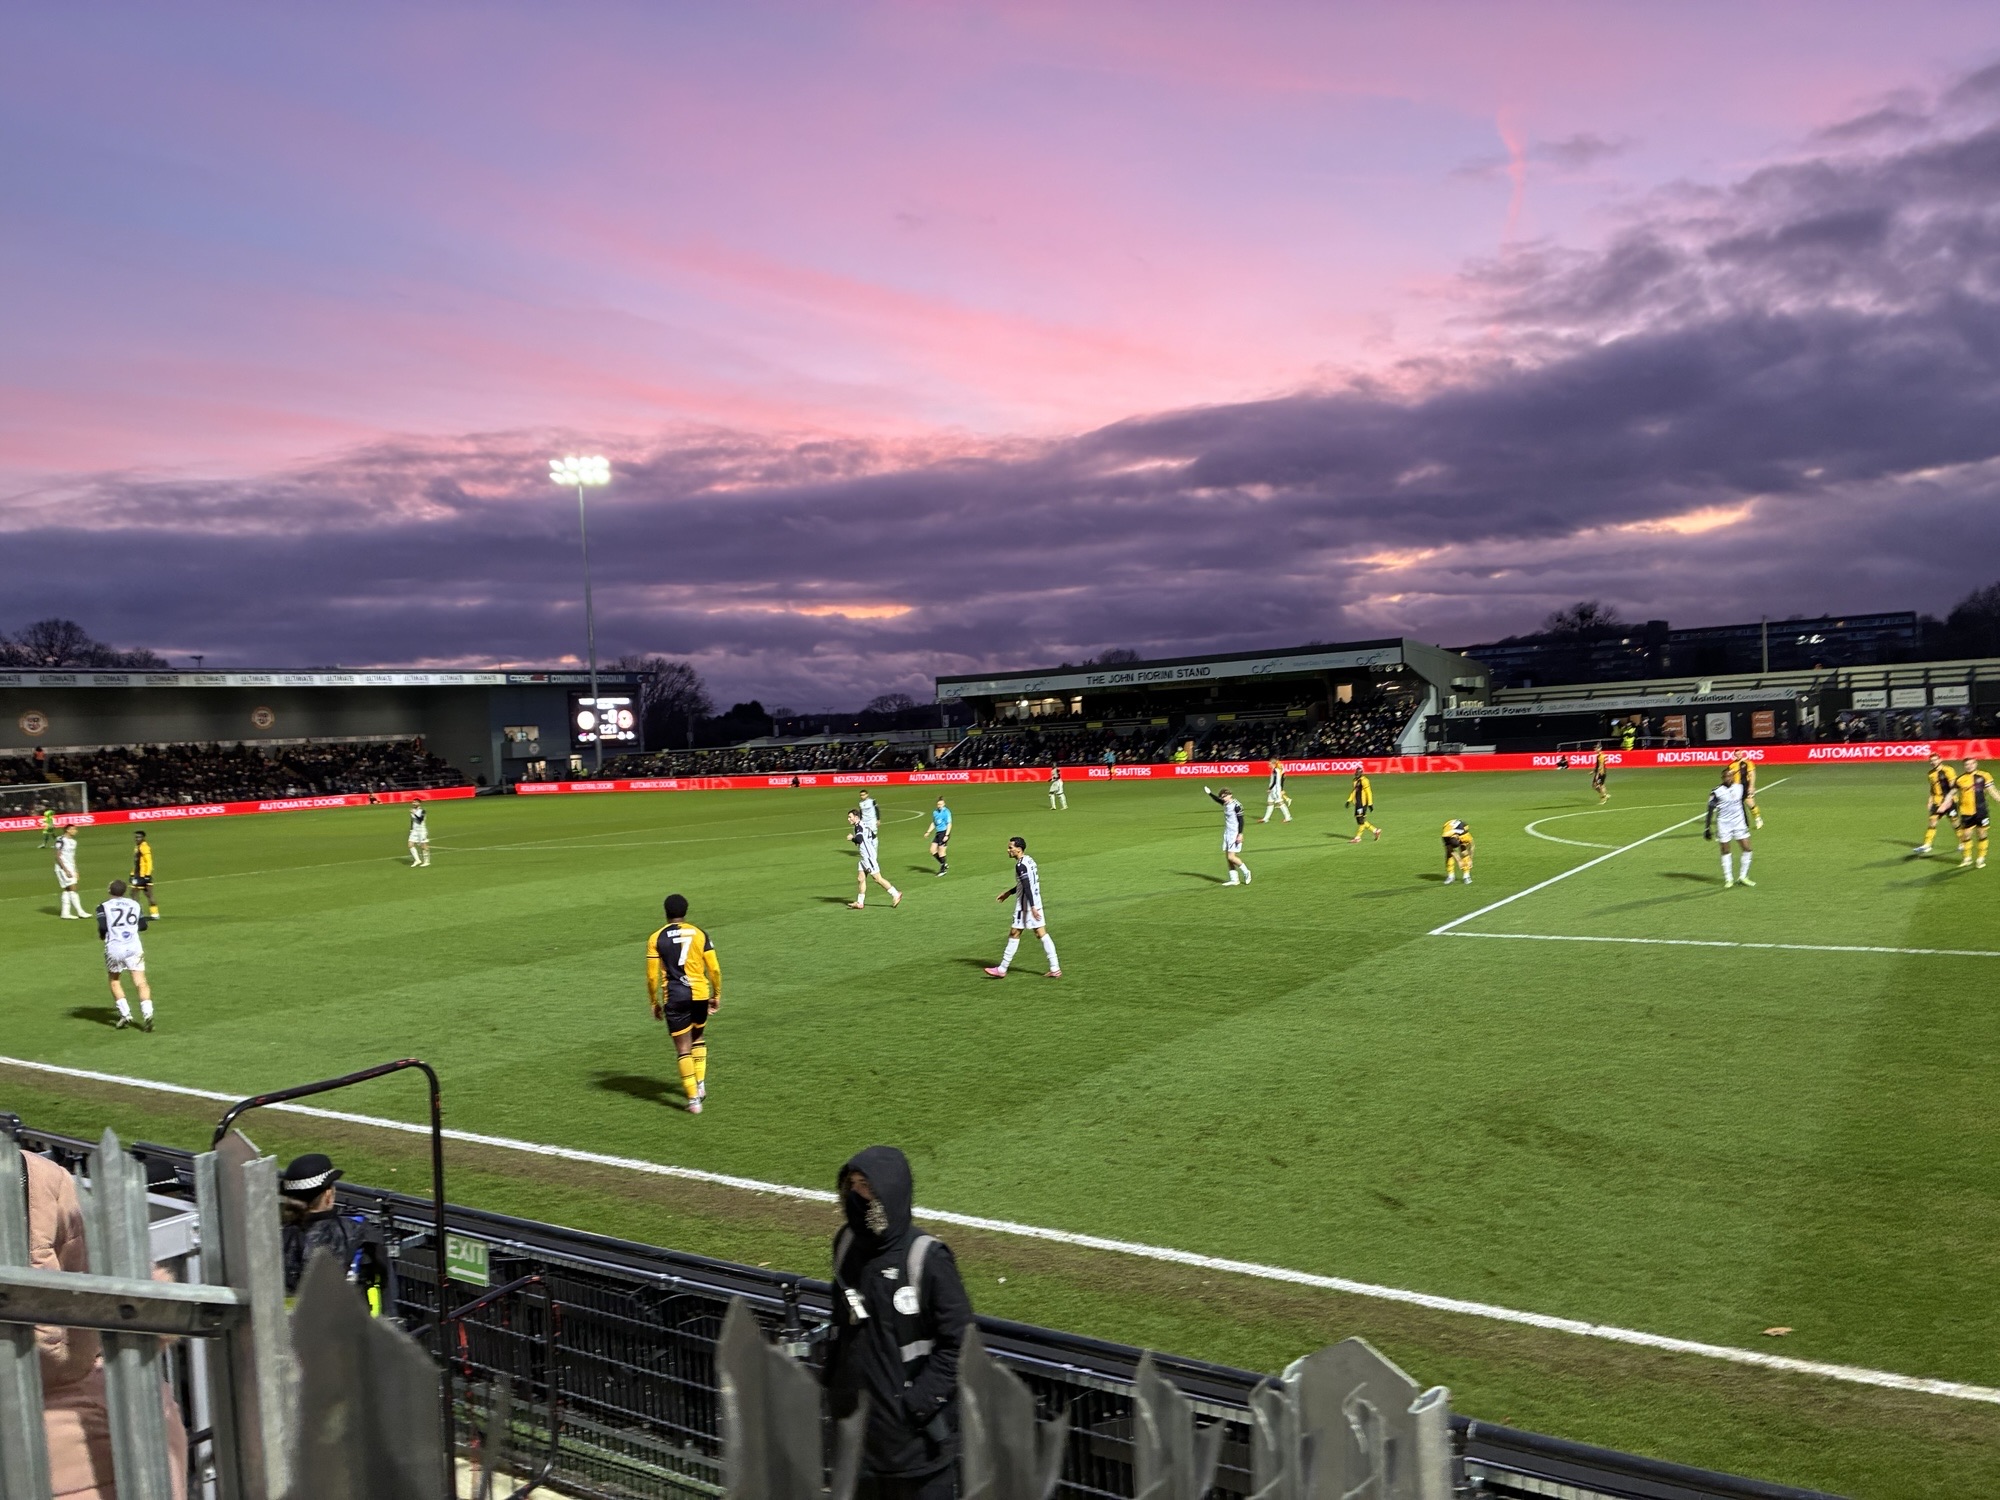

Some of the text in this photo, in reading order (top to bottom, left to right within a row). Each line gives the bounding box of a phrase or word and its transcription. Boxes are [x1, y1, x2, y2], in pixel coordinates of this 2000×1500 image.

[1086, 666, 1211, 685] THE JOHN FIORINI STAND
[1456, 706, 1532, 717] Mainland Power
[1657, 751, 1721, 763] INDUSTRIAL
[1808, 745, 1931, 759] AUTOMATIC DOORS
[1570, 753, 1622, 765] SHUTERS
[1089, 767, 1151, 777] ROLLE SHUTTERS
[1175, 764, 1249, 775] INDUSTRIAL DOORS
[1281, 760, 1364, 772] AUTOMATIC DOORS
[768, 778, 789, 786] ROLLER
[833, 775, 888, 784] INDUSTRIAL DOORS
[909, 772, 969, 782] AUTOMATIC DOORS
[630, 781, 658, 789] AUTOMATIC
[259, 797, 345, 811] AUTOMATIC DOORS
[129, 805, 225, 820] INDUSTRIAL DOORS
[37, 815, 94, 827] SUTTERS
[110, 906, 138, 928] 26
[672, 935, 693, 967] 7
[447, 1236, 486, 1265] EXIT
